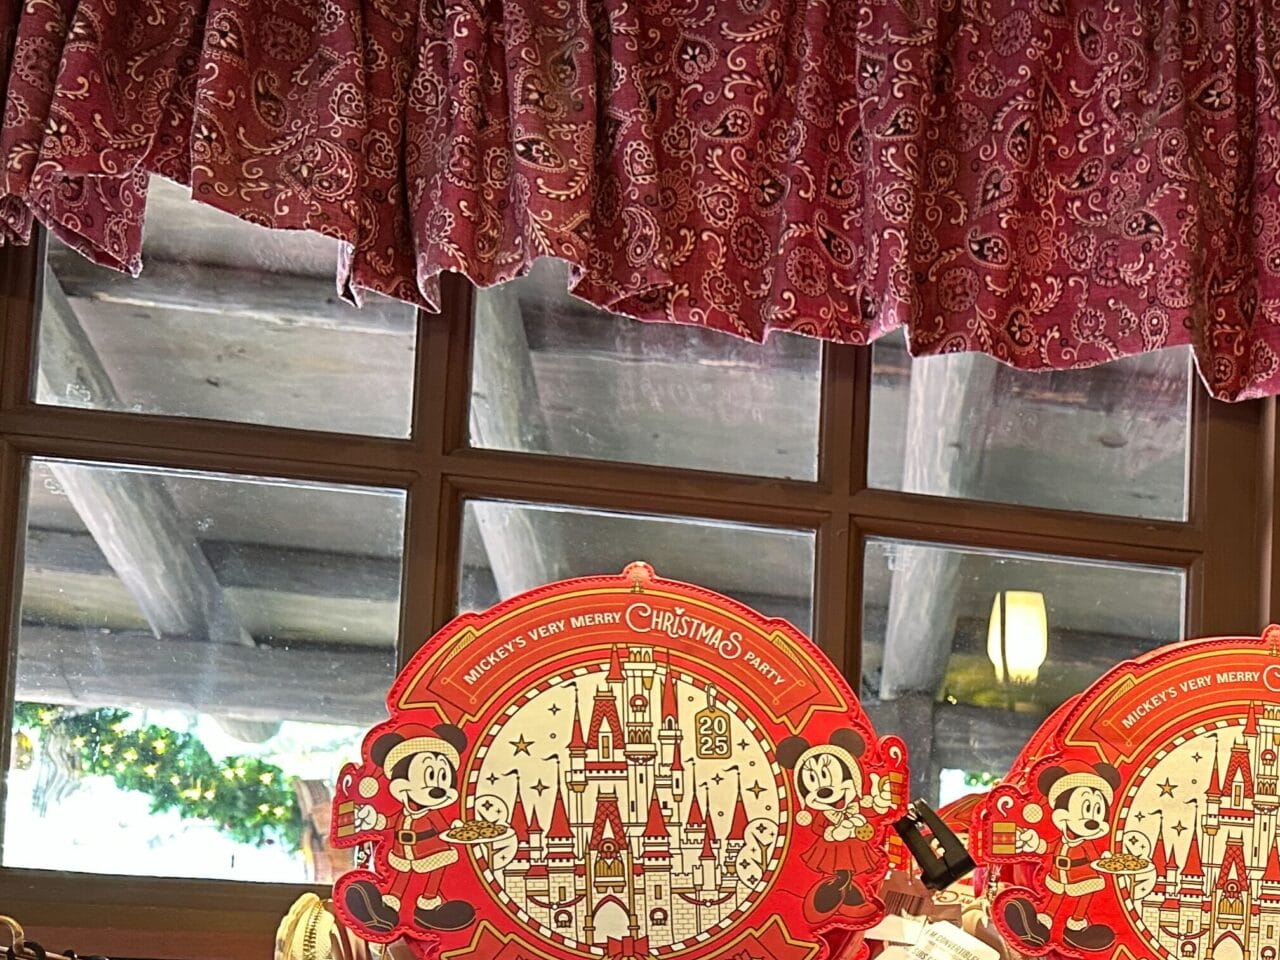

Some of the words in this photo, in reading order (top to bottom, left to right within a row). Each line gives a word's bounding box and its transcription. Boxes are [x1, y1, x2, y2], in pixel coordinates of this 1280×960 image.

[463, 636, 526, 686] MICKEY'S
[529, 620, 565, 642] VERY
[571, 611, 621, 629] MERRY
[626, 603, 743, 659] CHRISTMAS
[744, 651, 786, 687] PARTY
[1122, 688, 1178, 730] MICKEY'S
[1179, 674, 1212, 693] VERY
[1216, 672, 1261, 684] MERRY
[699, 716, 727, 734] 20
[700, 736, 728, 755] 25
